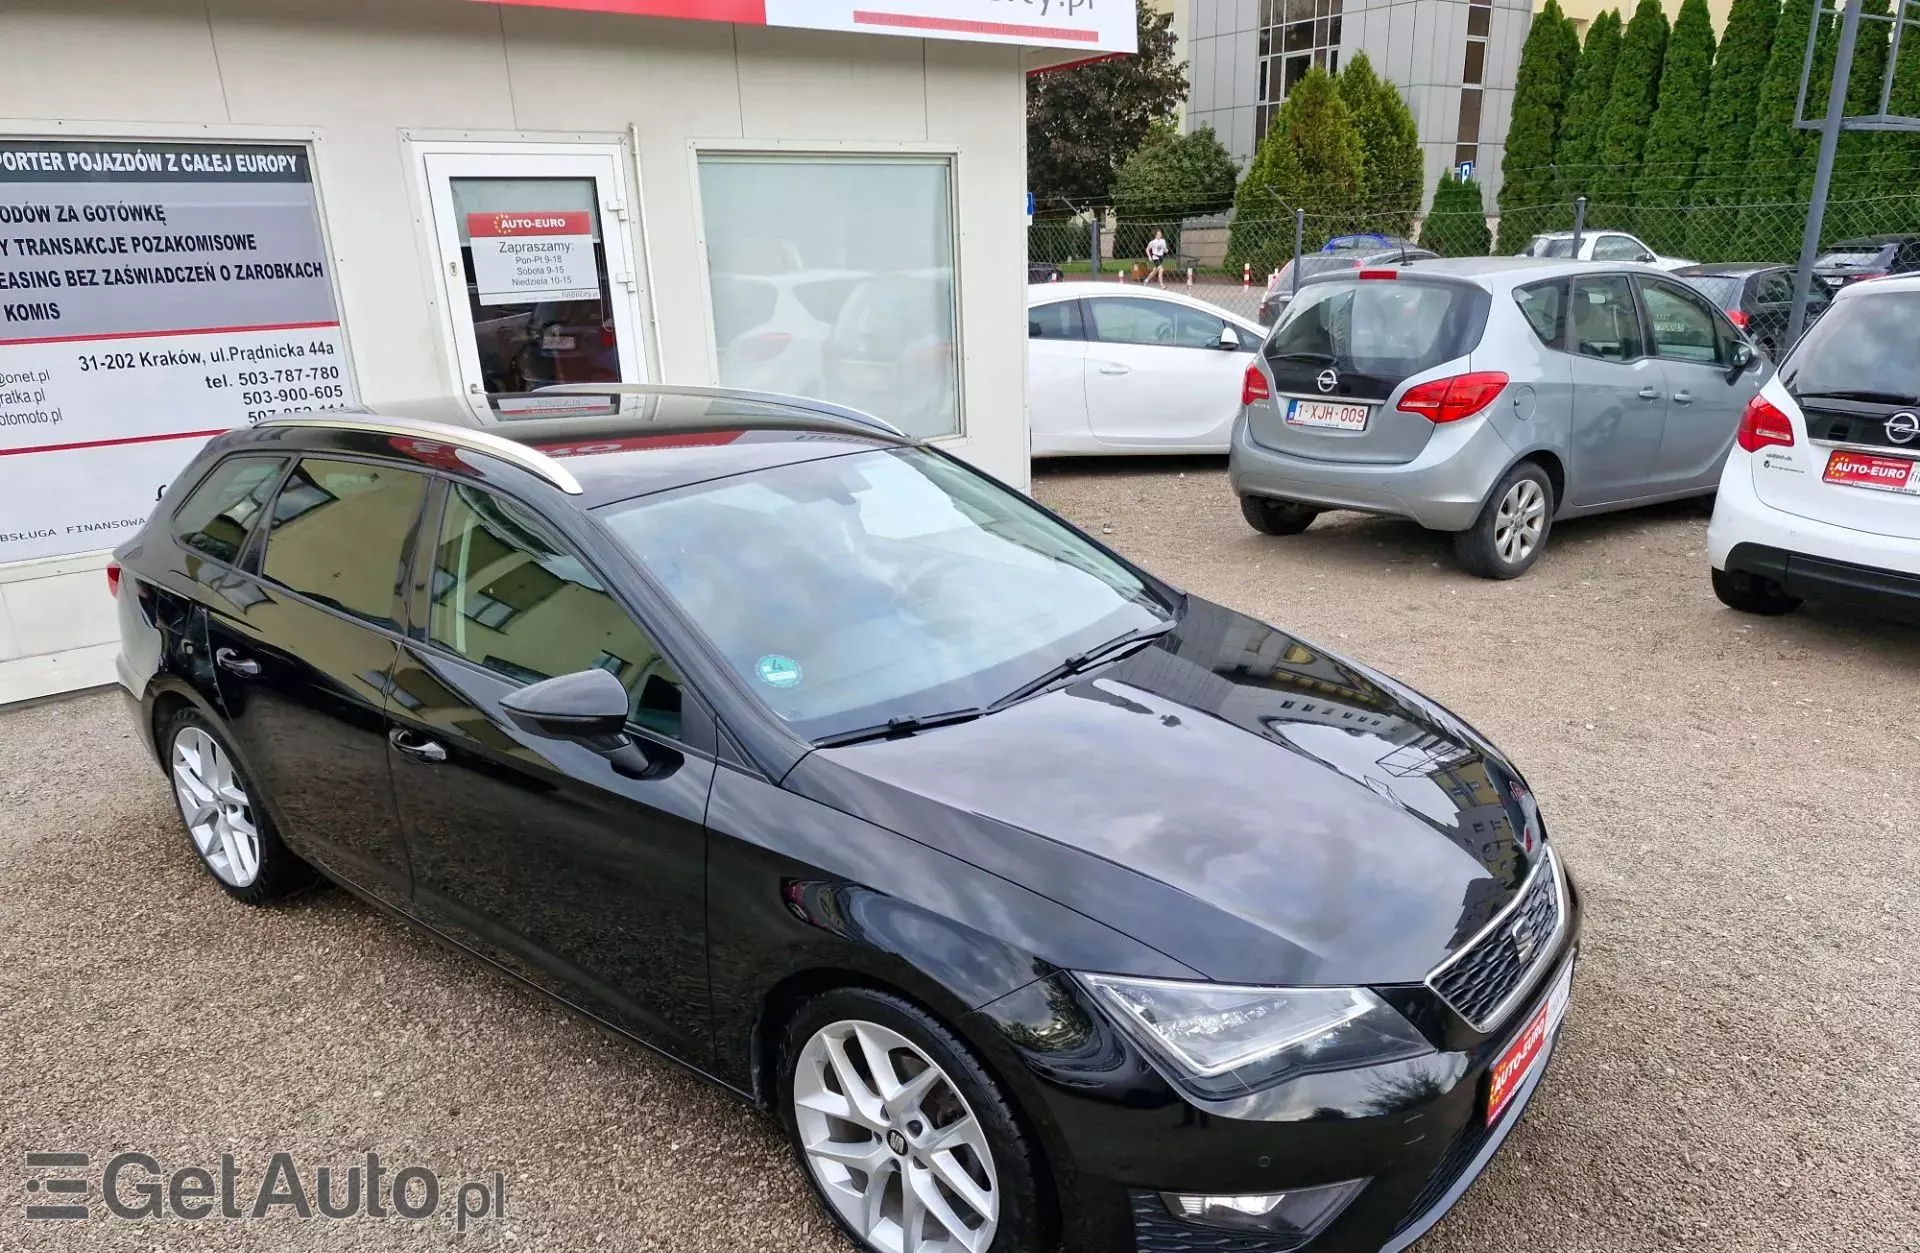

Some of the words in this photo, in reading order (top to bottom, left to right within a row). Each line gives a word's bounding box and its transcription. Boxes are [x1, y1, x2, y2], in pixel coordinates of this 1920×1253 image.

[0, 152, 66, 171] ORTER
[67, 149, 162, 172] POJAZDÓW
[167, 155, 178, 172] Z
[181, 154, 232, 172] CAŁEJ
[239, 155, 297, 173] EUROPY
[0, 201, 50, 223] ODÓW
[55, 204, 80, 222] ZA
[83, 201, 166, 226] GOTÓWKĘ
[501, 218, 566, 229] AUTO-EURO
[13, 235, 127, 256] TRANSAKCJE
[131, 233, 257, 254] POZAKOMISOWE
[498, 240, 574, 255] Zapraszamy:
[65, 269, 99, 287] BEZ
[102, 261, 217, 285] ZAŚWIADCZEŃ
[220, 264, 231, 281] O
[234, 261, 323, 280] ZAROBKACH
[517, 266, 545, 276] Sobota
[4, 302, 61, 322] KOMIS
[78, 352, 137, 372] 31-202
[139, 349, 206, 368] Kraków,
[210, 343, 305, 364] ul.Prądnicka
[309, 341, 334, 356] 44a
[205, 374, 233, 389] tel.
[239, 366, 339, 386] 503-787-780
[0, 387, 46, 408] ratka.pl
[242, 384, 343, 405] 503-900-605
[0, 407, 63, 426] otomoto.pl
[1834, 461, 1906, 479] AUTO-EURO
[66, 517, 147, 534] FINANSOWA
